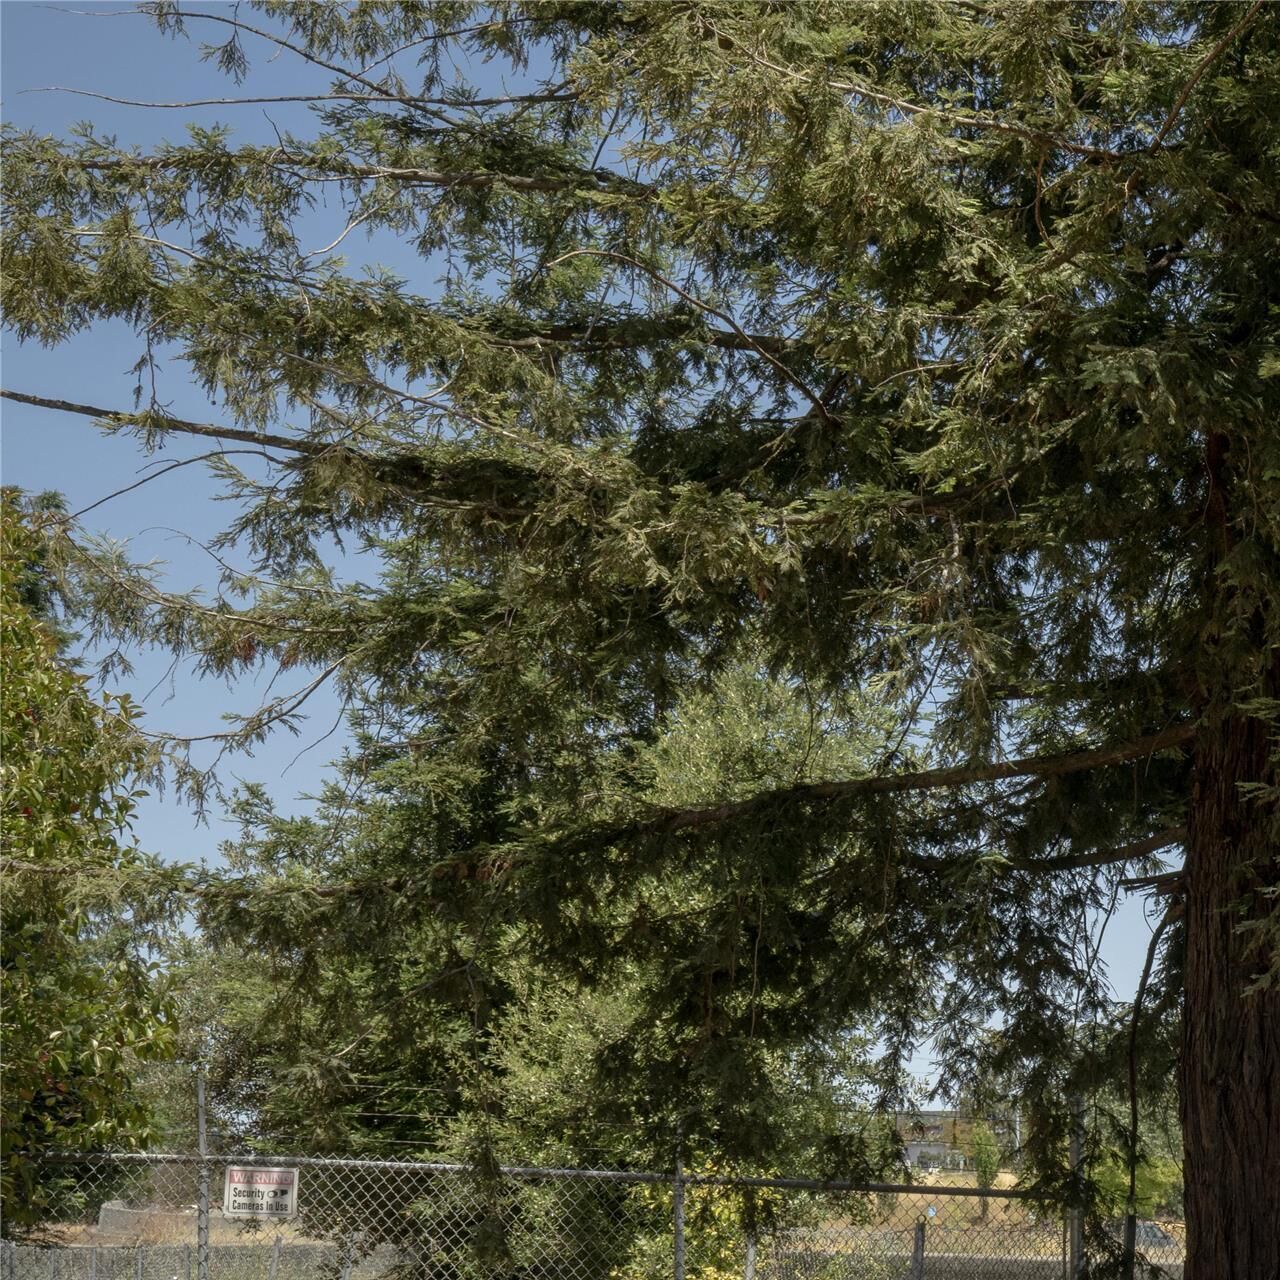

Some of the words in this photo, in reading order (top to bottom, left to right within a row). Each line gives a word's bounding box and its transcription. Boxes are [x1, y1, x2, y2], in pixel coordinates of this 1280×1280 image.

[233, 1172, 291, 1184] WARNING
[233, 1187, 265, 1200] Security
[232, 1200, 264, 1211] Cameras
[266, 1201, 273, 1211] In
[275, 1201, 288, 1212] Use
